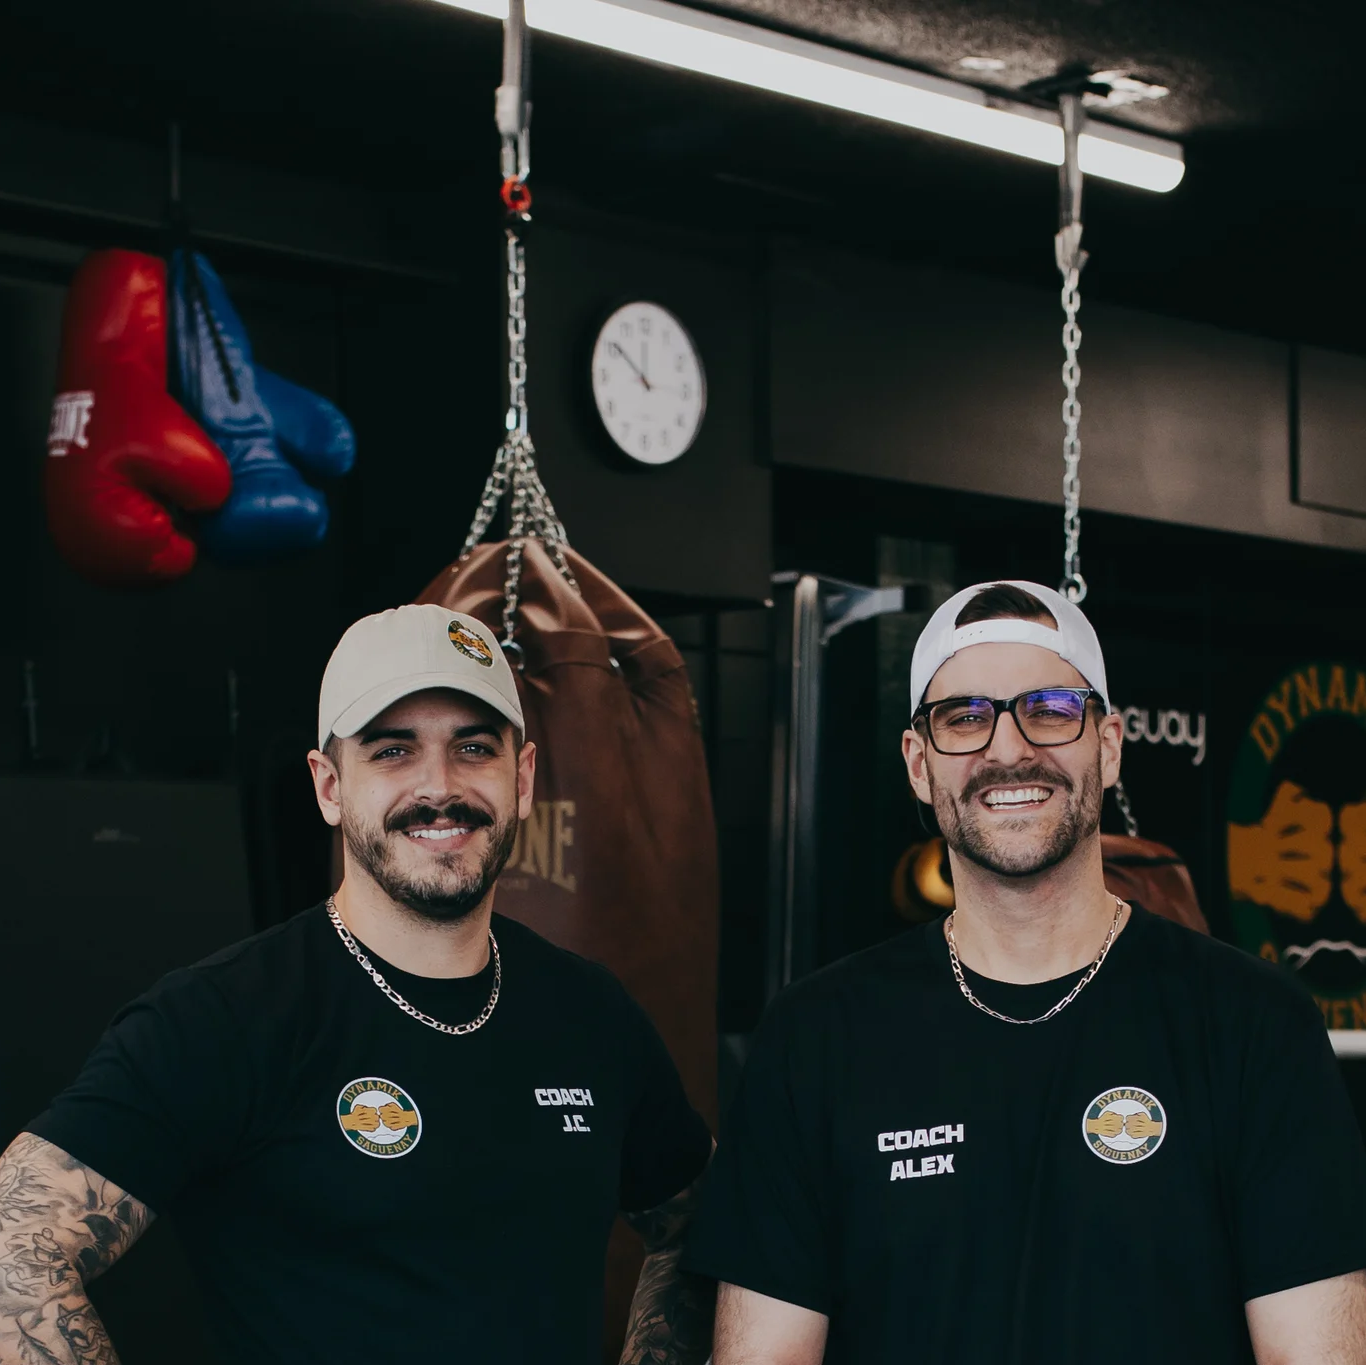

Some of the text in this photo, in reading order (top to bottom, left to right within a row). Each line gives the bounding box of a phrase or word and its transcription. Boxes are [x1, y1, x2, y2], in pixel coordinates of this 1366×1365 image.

[343, 1081, 403, 1104] DYNAMIK
[535, 1088, 594, 1106] COACH
[1095, 1089, 1157, 1112] DYNAMIK
[562, 1115, 591, 1132] J.C.
[355, 1133, 415, 1155] SAGUENAY
[878, 1123, 964, 1152] COACH
[1092, 1139, 1152, 1161] SAGUENAY
[890, 1153, 955, 1181] ALEX
